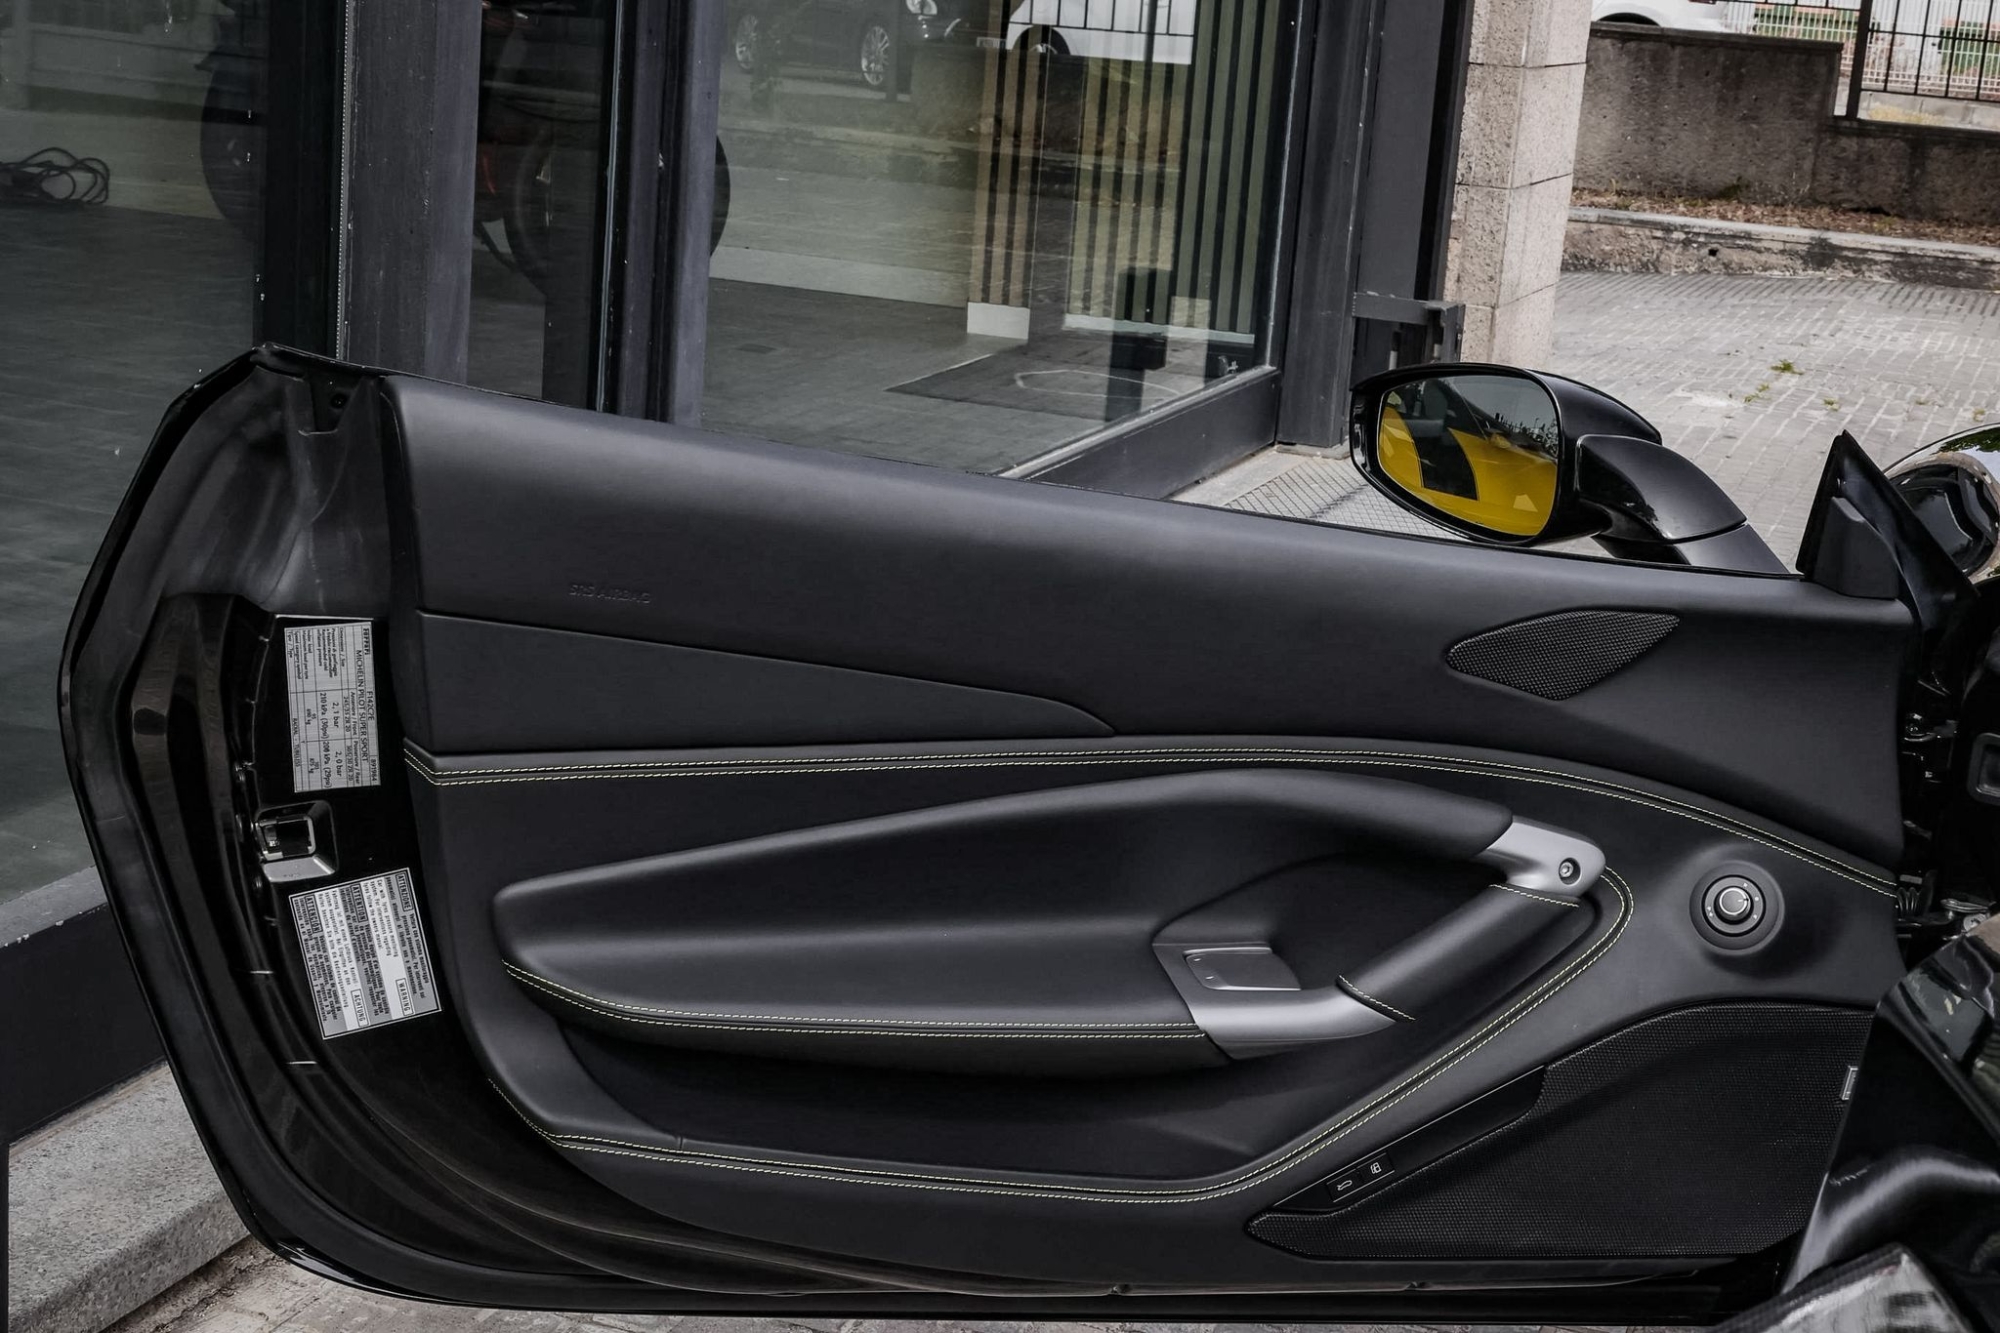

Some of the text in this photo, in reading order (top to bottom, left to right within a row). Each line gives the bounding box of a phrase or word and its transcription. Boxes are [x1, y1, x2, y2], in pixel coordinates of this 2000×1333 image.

[318, 692, 327, 703] 210
[319, 704, 327, 715] kPa
[355, 649, 363, 687] MICHELIN
[360, 737, 368, 762] SPORT
[352, 885, 366, 920] ATTENTION
[397, 875, 410, 908] ATTENZIONE
[352, 993, 365, 1022] ACHTUNG
[398, 982, 410, 1011] WARNING
